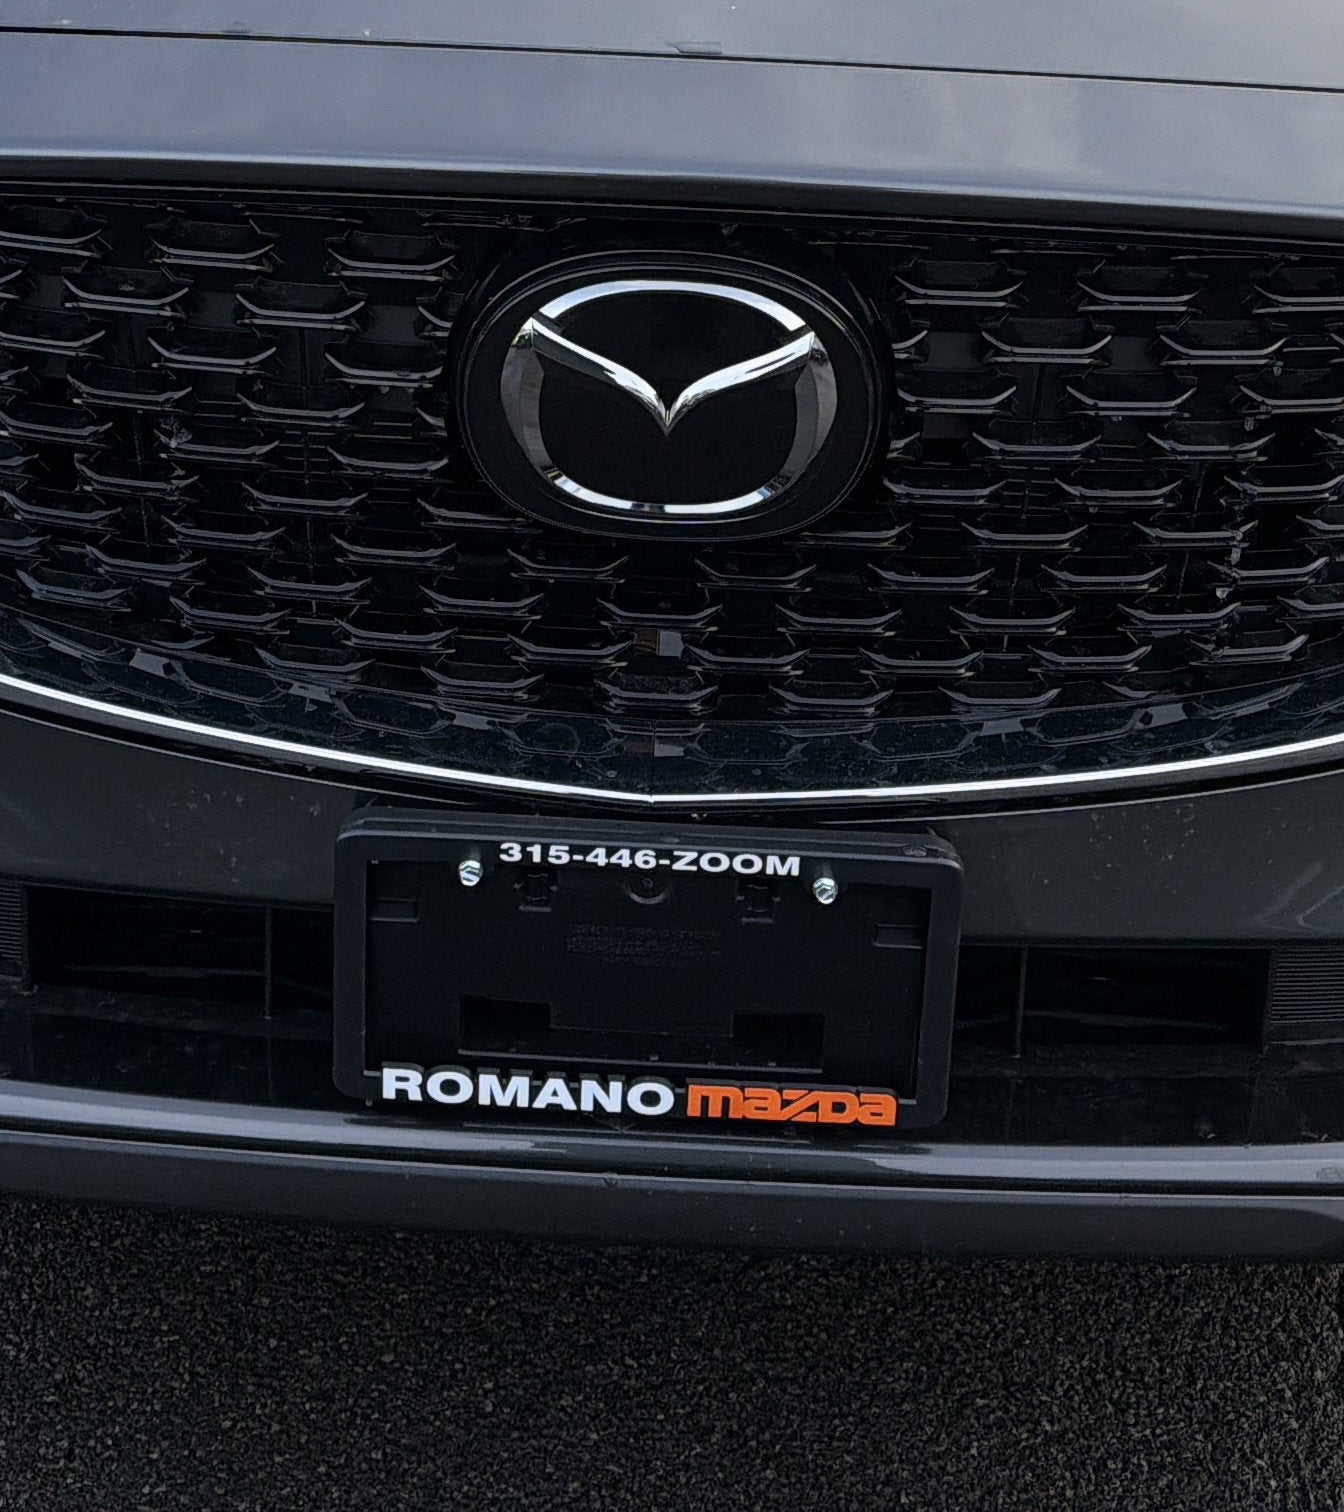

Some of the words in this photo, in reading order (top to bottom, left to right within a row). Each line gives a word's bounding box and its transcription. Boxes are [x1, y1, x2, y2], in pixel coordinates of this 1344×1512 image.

[499, 841, 802, 877] 315-446-ZOOM
[381, 1066, 675, 1117] ROMANO
[686, 1083, 898, 1128] mazda
